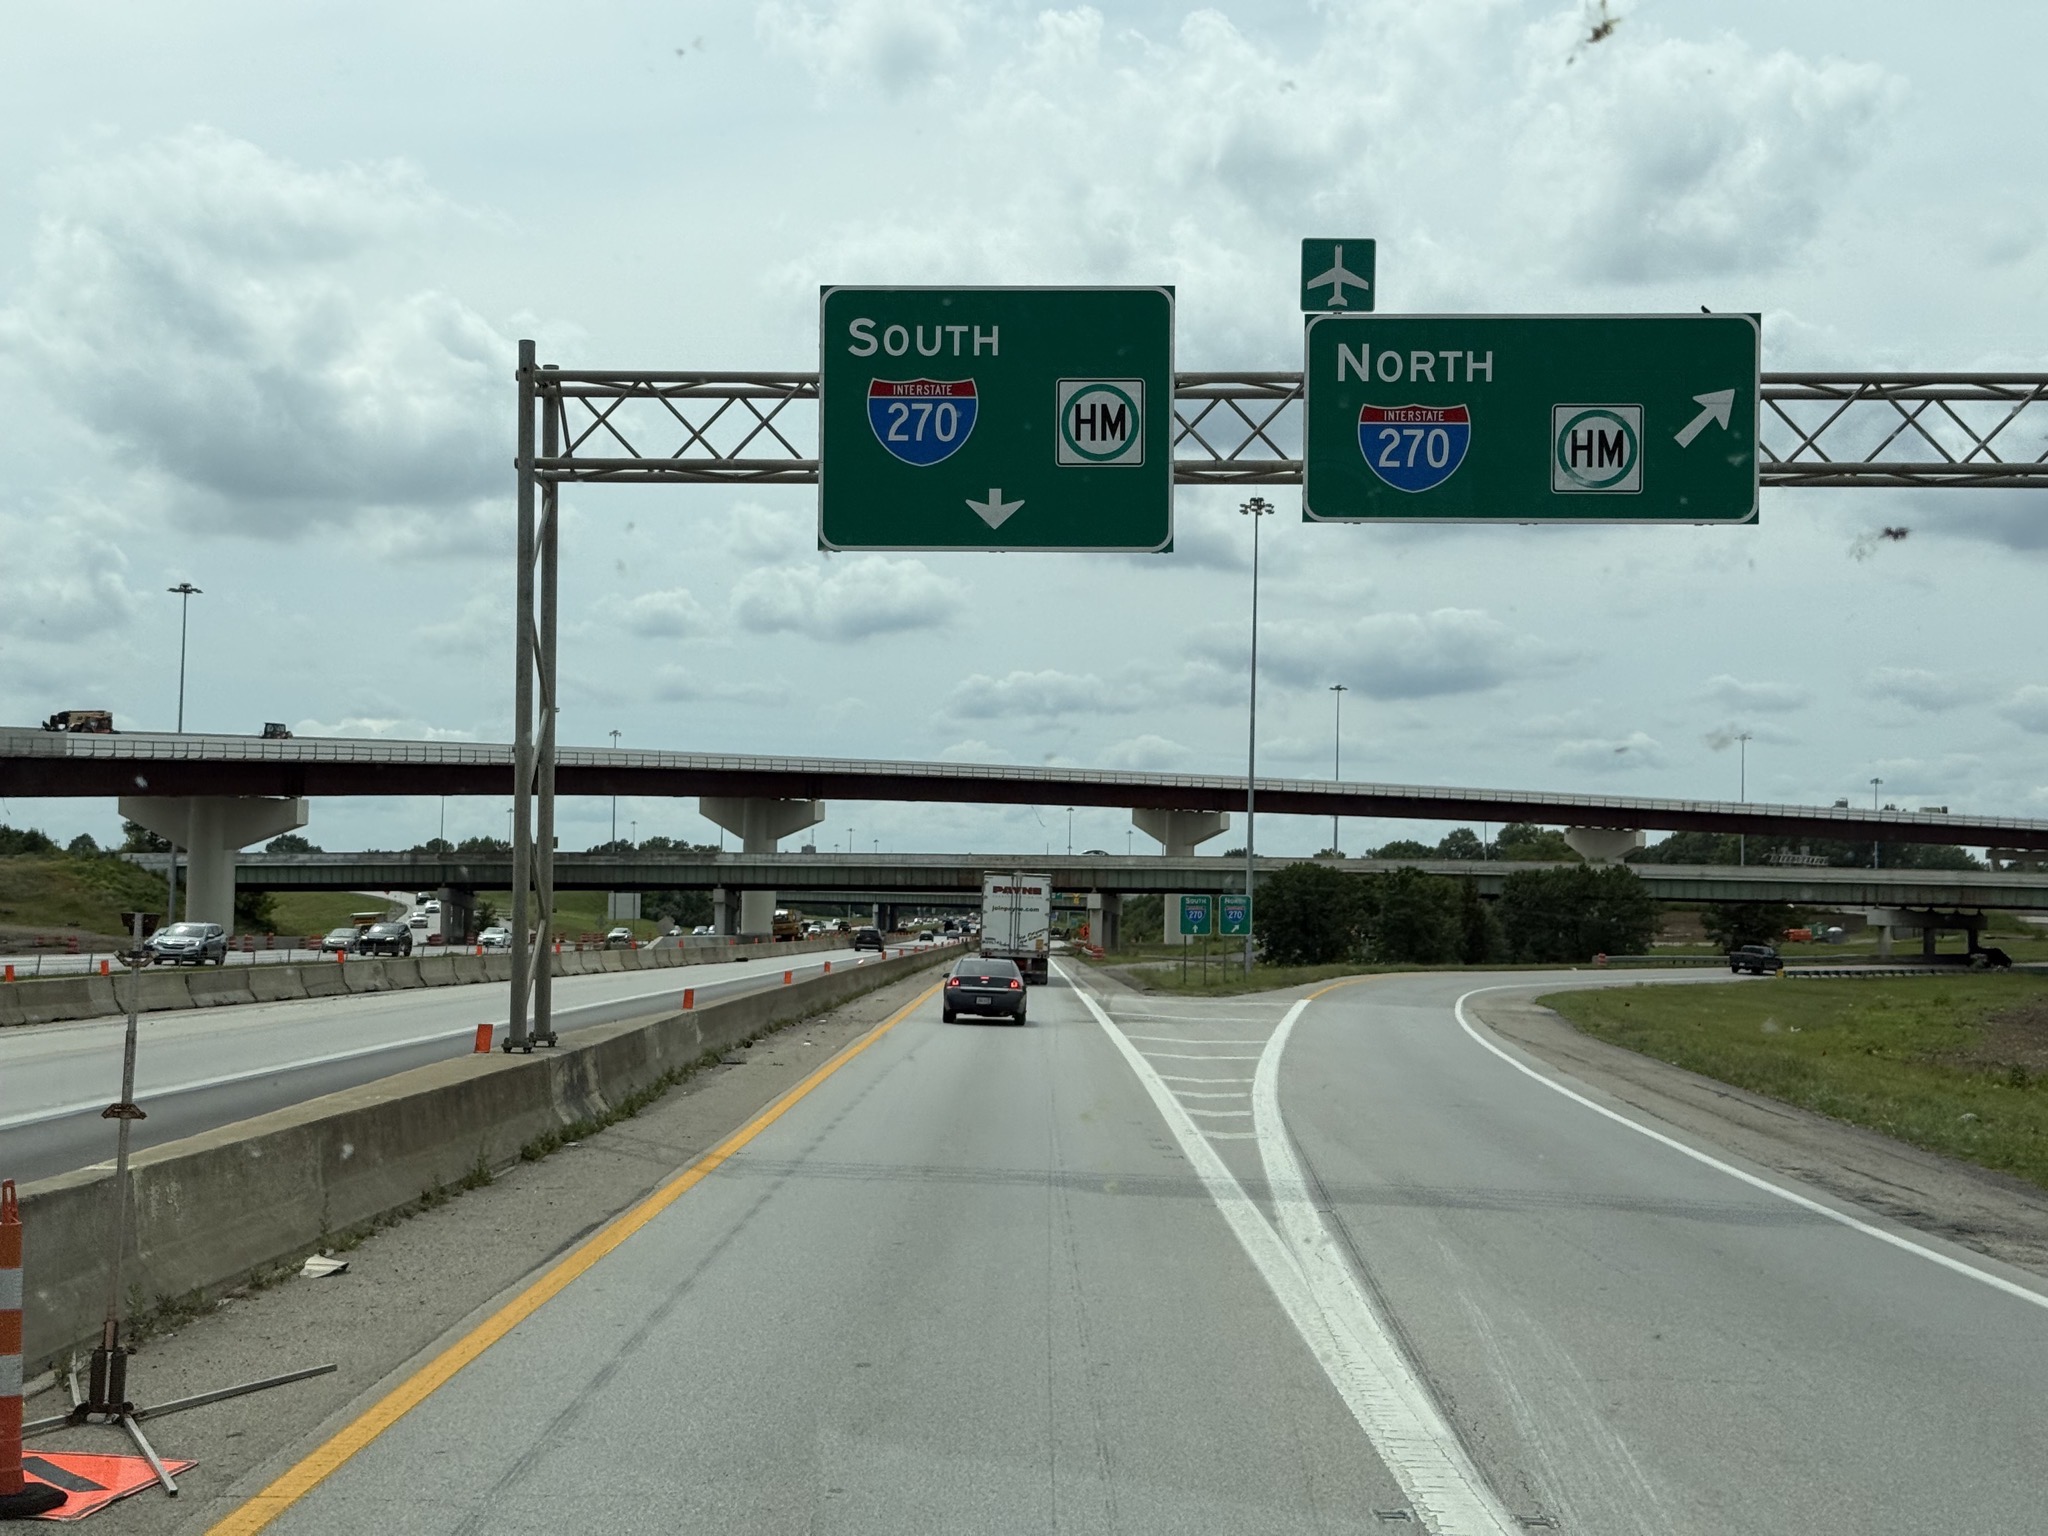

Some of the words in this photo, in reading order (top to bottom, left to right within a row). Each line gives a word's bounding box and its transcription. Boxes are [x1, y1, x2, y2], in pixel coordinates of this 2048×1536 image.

[848, 317, 999, 357] SOUTH
[1337, 343, 1492, 382] NORTH
[892, 384, 953, 396] INTERSTATE
[887, 402, 957, 443] 270
[1074, 403, 1126, 442] HM
[1384, 410, 1444, 422] INTERSTATE
[1378, 428, 1449, 468] 270
[1571, 430, 1624, 468] HM
[993, 886, 1042, 895] PAYNE
[1188, 911, 1203, 919] 270
[1228, 911, 1242, 919] 270
